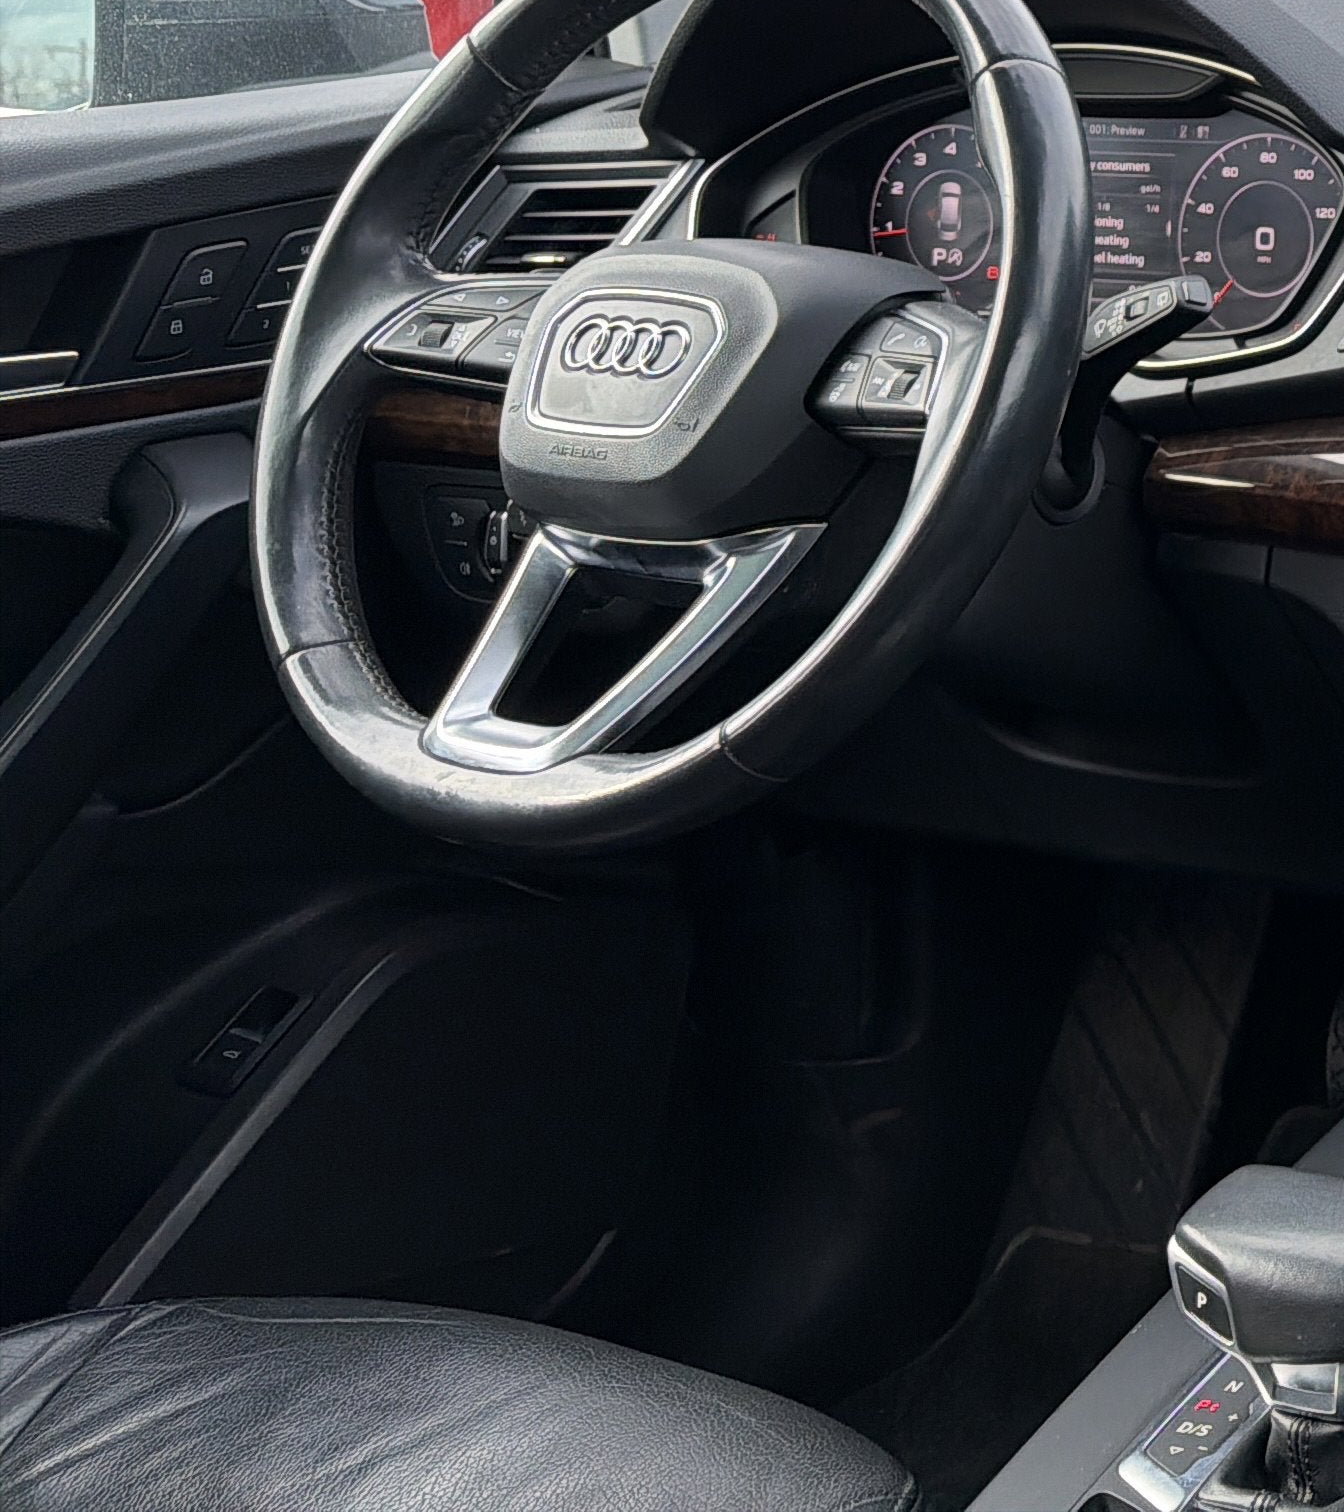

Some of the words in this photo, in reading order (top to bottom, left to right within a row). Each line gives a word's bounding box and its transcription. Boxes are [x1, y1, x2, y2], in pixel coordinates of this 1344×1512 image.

[1111, 125, 1145, 136] Preview
[943, 142, 957, 156] 4
[913, 153, 927, 166] 3
[1260, 152, 1278, 164] 80
[1097, 162, 1151, 173] consumers
[1222, 166, 1239, 178] 60
[1294, 169, 1315, 181] 100
[891, 181, 904, 195] 2
[1197, 203, 1215, 215] 40
[1315, 207, 1336, 219] 120
[1255, 226, 1275, 251] 0
[932, 247, 946, 267] P
[1107, 252, 1145, 268] heating
[1193, 251, 1212, 263] 20
[549, 442, 608, 460] AIRBAG
[1197, 1291, 1208, 1309] P
[1224, 1380, 1245, 1393] N
[1175, 1421, 1213, 1437] D/S
